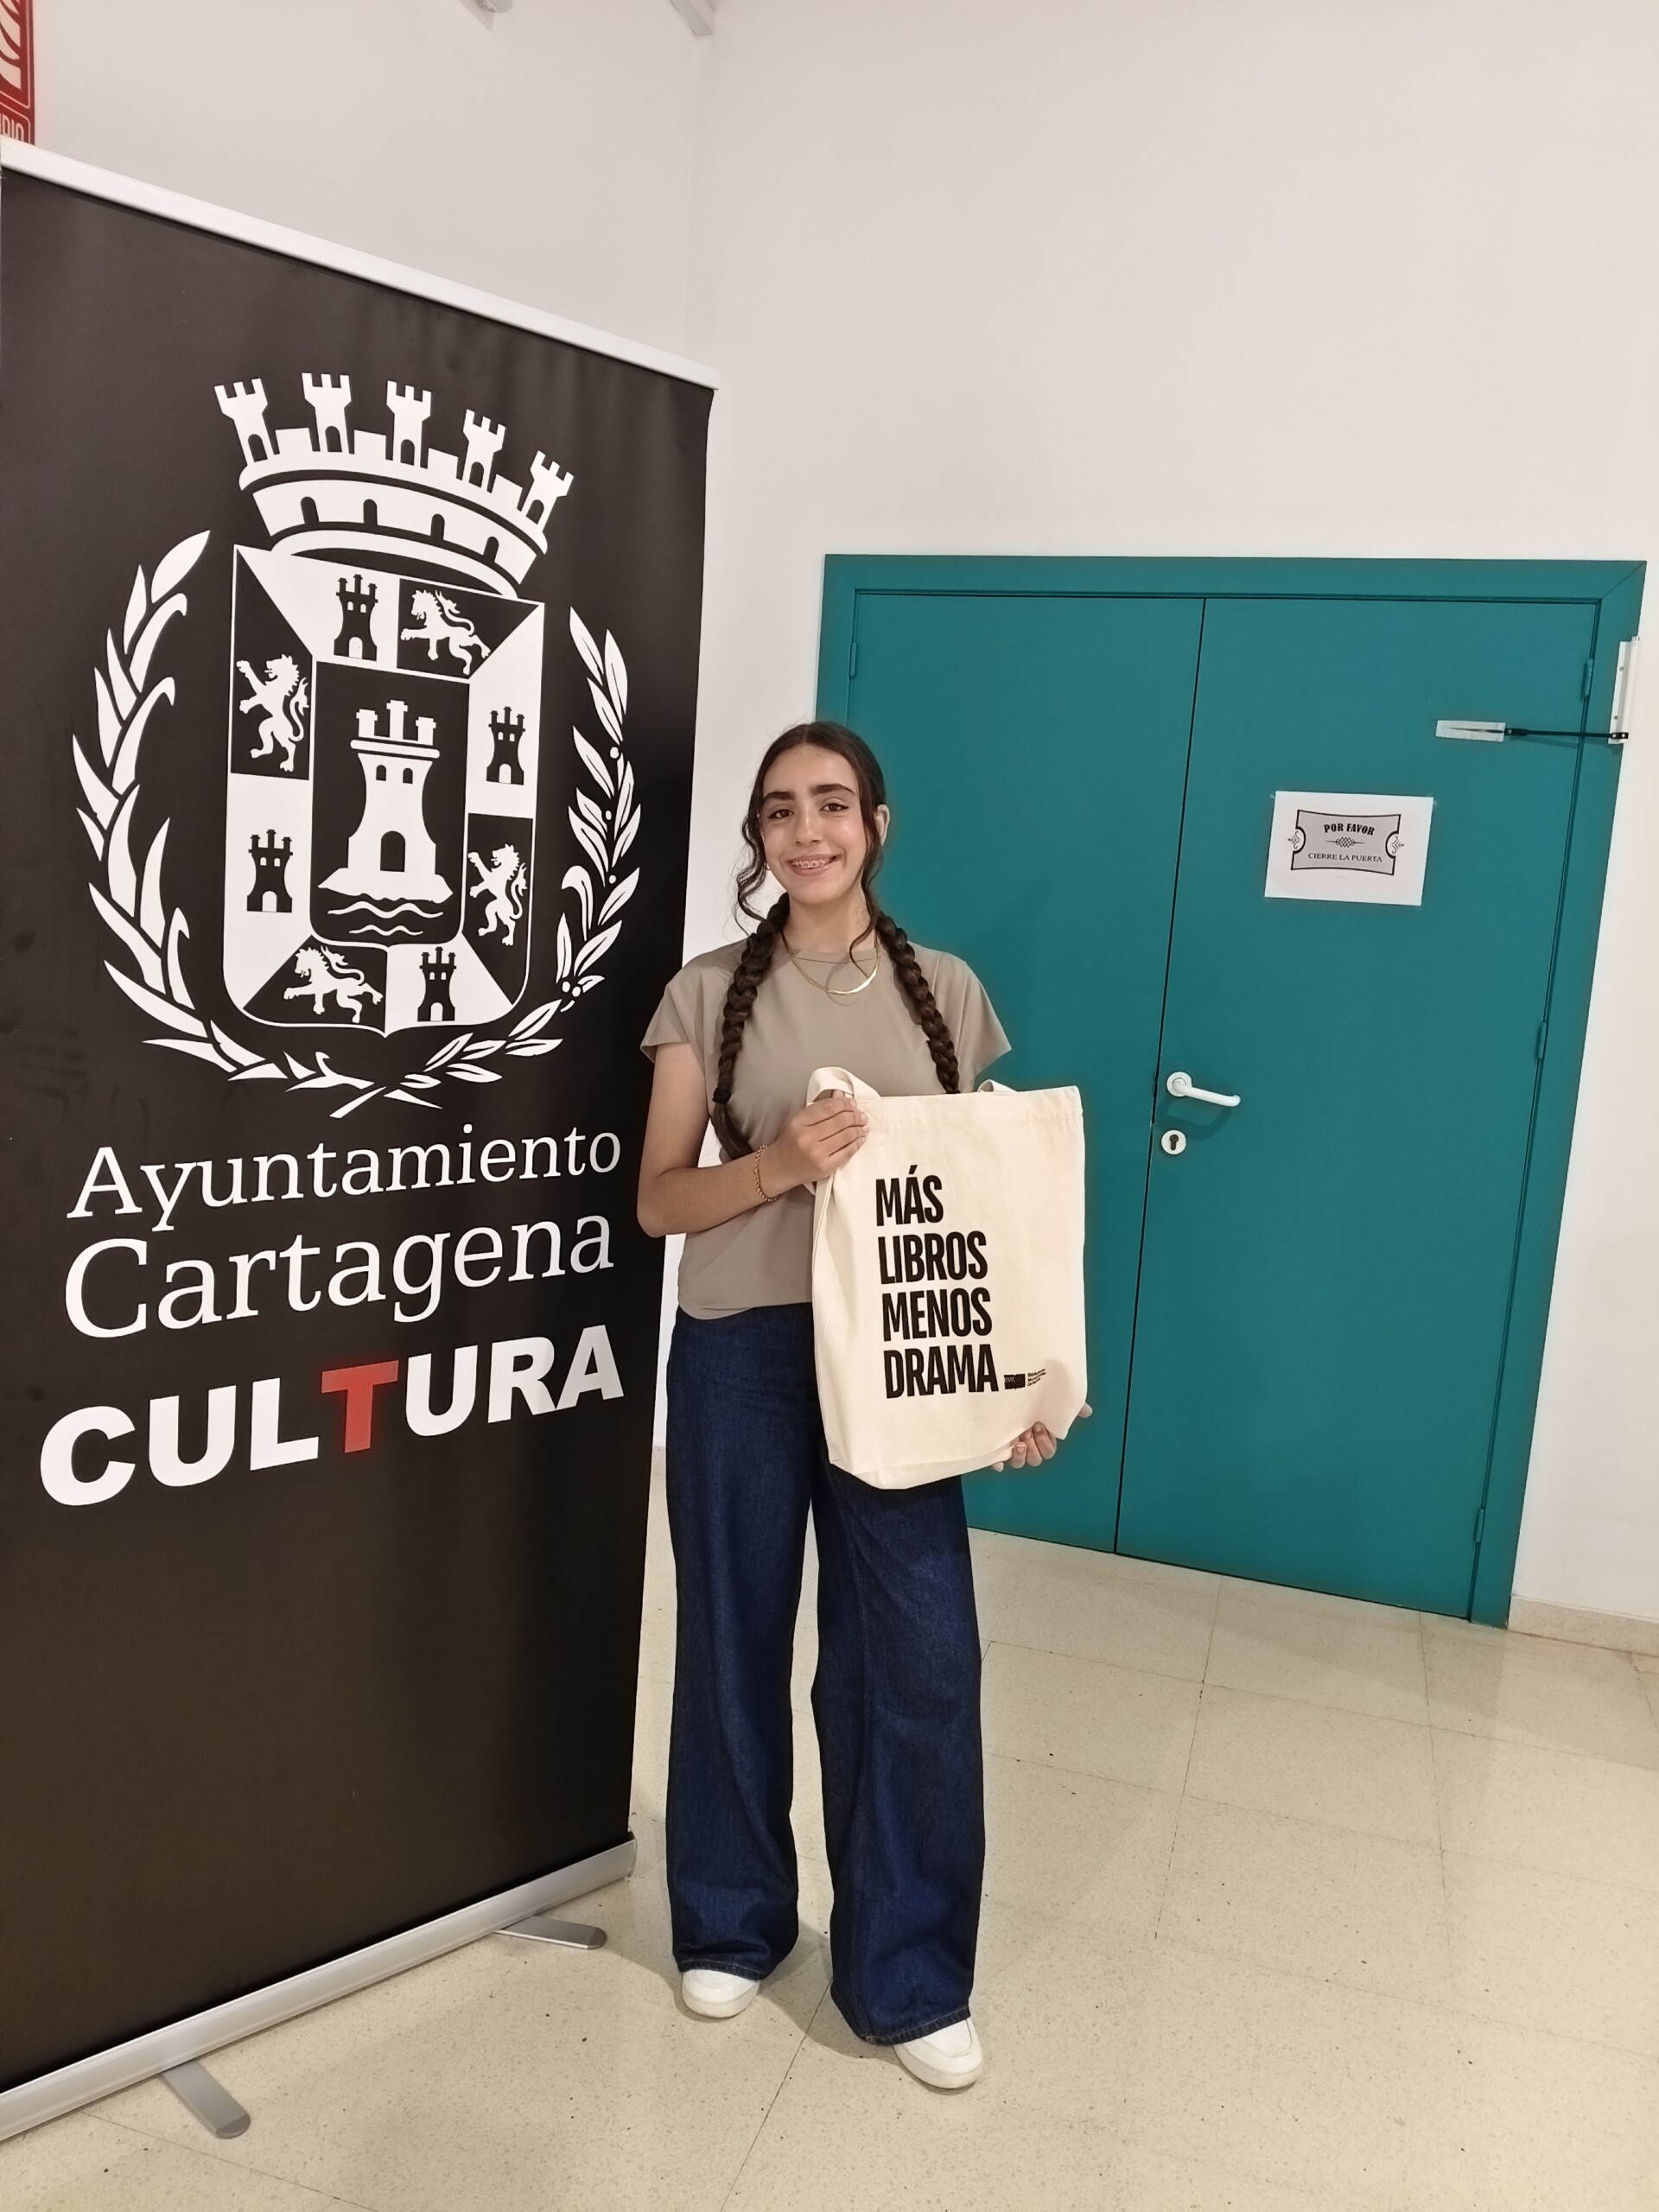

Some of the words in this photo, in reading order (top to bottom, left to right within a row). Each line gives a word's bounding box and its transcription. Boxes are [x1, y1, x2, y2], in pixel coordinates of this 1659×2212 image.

[1307, 852, 1338, 861] CIERRE
[1323, 823, 1344, 834] POR
[1345, 823, 1376, 836] FAVOR
[66, 1123, 621, 1232] Ayuntamiento
[875, 1164, 944, 1227] MÁS
[65, 1214, 615, 1339] Cartagena
[877, 1230, 988, 1285] LIBROS
[881, 1287, 993, 1342] MENOS
[883, 1344, 1000, 1399] DRAMA
[40, 1324, 625, 1507] CULTURA
